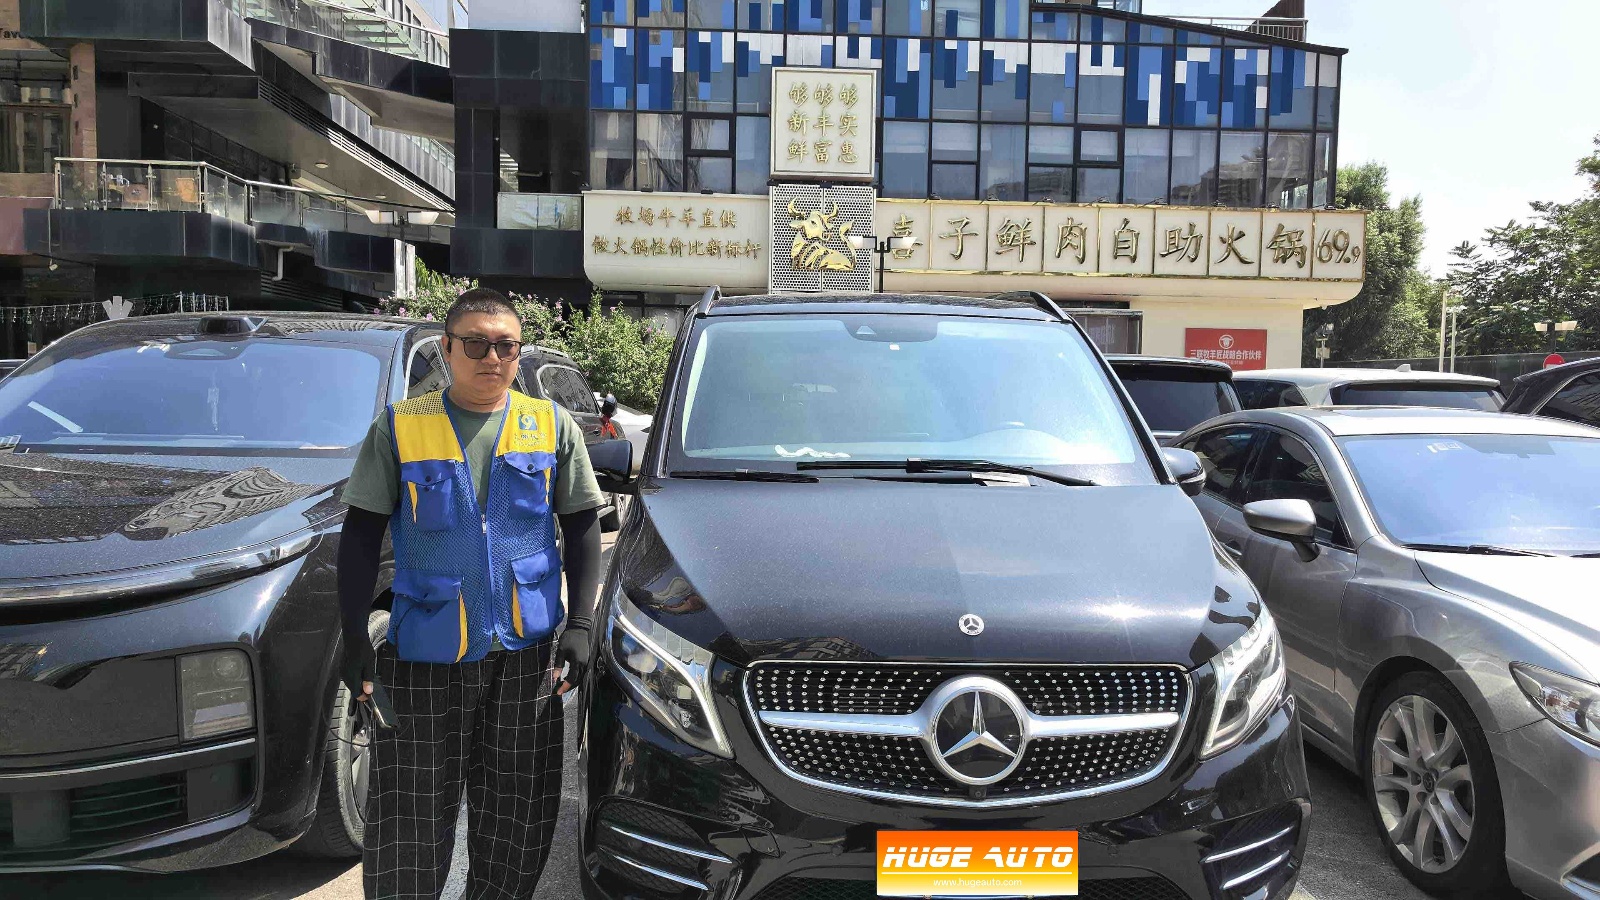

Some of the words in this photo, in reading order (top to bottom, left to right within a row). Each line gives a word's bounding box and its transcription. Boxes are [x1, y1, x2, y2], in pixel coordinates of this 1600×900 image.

[787, 82, 809, 163] 够新鲜
[813, 83, 834, 164] 够丰富
[838, 83, 858, 164] 够实惠
[592, 234, 762, 260] 做火锅性价比新标杆
[616, 206, 738, 229] 牧场牛羊直供
[885, 213, 1308, 268] 喜子鲜肉自助火锅
[1315, 228, 1361, 264] 69.9
